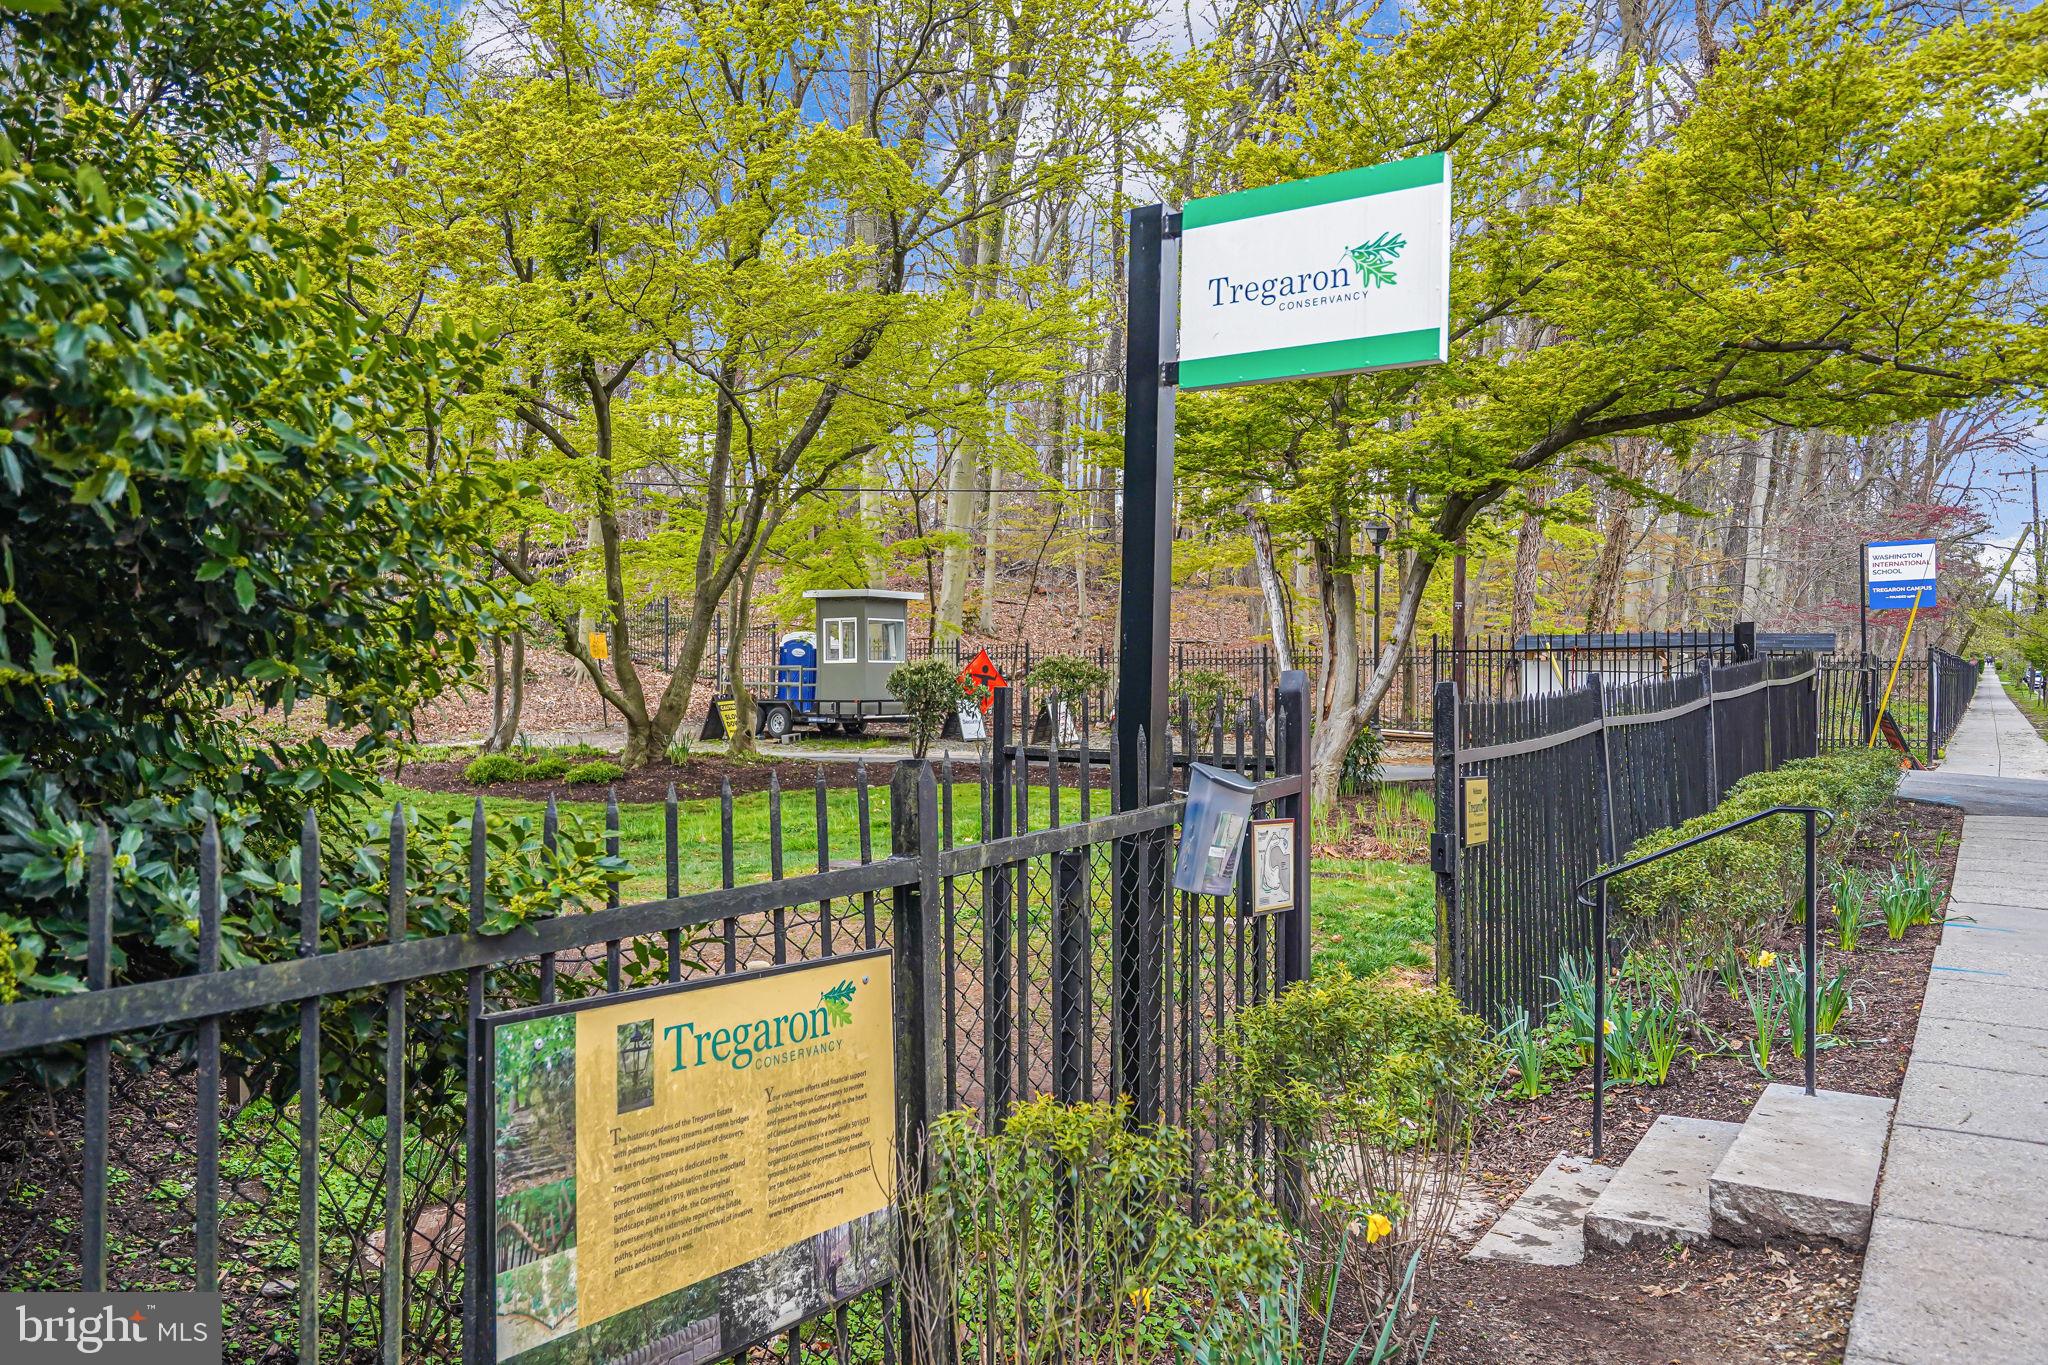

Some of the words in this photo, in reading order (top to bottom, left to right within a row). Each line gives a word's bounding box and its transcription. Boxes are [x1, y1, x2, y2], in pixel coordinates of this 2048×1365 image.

[1208, 267, 1351, 308] Tregaron
[1278, 290, 1369, 311] CONSERVANCY
[1872, 552, 1923, 560] WASHINGTON
[1872, 560, 1931, 568] INTERNATIONAL
[664, 1006, 830, 1072] Tregaron
[755, 1039, 843, 1070] CONSERVANCY
[766, 1105, 783, 1115] enable
[793, 1097, 814, 1107] Tregaron
[814, 1089, 843, 1102] Conservancy
[849, 1083, 864, 1091] restore
[781, 1087, 805, 1099] volunteer
[805, 1083, 820, 1091] efforts
[830, 1074, 849, 1085] financial
[849, 1070, 867, 1080] support
[628, 1131, 649, 1142] historic
[650, 1124, 673, 1136] gardens
[675, 1120, 681, 1128] of
[682, 1118, 691, 1126] the
[692, 1113, 716, 1124] Tregaron
[717, 1107, 732, 1117] Estate
[766, 1119, 777, 1127] and
[777, 1113, 798, 1125] preserve
[799, 1110, 807, 1118] this
[808, 1102, 831, 1114] woodland
[831, 1100, 841, 1109] gem
[855, 1092, 867, 1100] heart
[613, 1149, 626, 1159] with
[658, 1135, 680, 1146] flowing
[681, 1129, 702, 1139] streams
[703, 1124, 714, 1133] and
[715, 1121, 729, 1130] stone
[730, 1115, 749, 1126] bridges
[767, 1132, 773, 1140] of
[773, 1126, 797, 1138] Cleveland
[798, 1122, 806, 1130] and
[807, 1116, 827, 1128] Woodley
[768, 1144, 789, 1155] Tregaron
[790, 1135, 819, 1148] Conservancy
[633, 1155, 660, 1168] enduring
[661, 1148, 684, 1159] treasure
[685, 1143, 695, 1152] and
[696, 1138, 711, 1150] place
[712, 1135, 718, 1143] of
[767, 1153, 798, 1167] organization
[799, 1143, 823, 1157] committed
[829, 1135, 850, 1147] restoring
[767, 1168, 788, 1180] grounds
[796, 1159, 811, 1170] public
[838, 1147, 848, 1155] Your
[848, 1140, 870, 1152] donations
[614, 1180, 640, 1193] Tregaron
[642, 1168, 678, 1184] Conservancy
[685, 1158, 711, 1171] dedicated
[712, 1155, 718, 1163] to
[720, 1152, 728, 1160] the
[614, 1191, 652, 1209] preservation
[652, 1186, 663, 1195] and
[665, 1174, 702, 1191] rehabilitation
[703, 1170, 709, 1178] of
[710, 1167, 718, 1176] the
[720, 1158, 745, 1173] woodland
[768, 1199, 777, 1209] For
[813, 1181, 825, 1190] ways
[825, 1179, 834, 1188] you
[855, 1165, 871, 1176] contact
[614, 1208, 635, 1223] garden
[636, 1198, 664, 1214] designed
[686, 1186, 699, 1197] With
[700, 1184, 709, 1192] the
[710, 1177, 730, 1190] original
[614, 1219, 645, 1235] landscape
[646, 1215, 658, 1228] plan
[690, 1200, 699, 1209] the
[700, 1189, 734, 1205] Conservancy
[769, 1187, 844, 1219] www.tregaronconservancy.org
[621, 1230, 653, 1246] overseeing
[654, 1226, 664, 1235] the
[665, 1216, 691, 1231] extensive
[693, 1211, 709, 1222] repair
[716, 1205, 725, 1213] the
[726, 1198, 741, 1209] bridle
[634, 1239, 665, 1257] pedestrian
[667, 1234, 680, 1243] trails
[682, 1228, 692, 1238] and
[694, 1225, 703, 1233] the
[704, 1218, 725, 1231] removal
[726, 1215, 732, 1223] of
[732, 1207, 754, 1220] invasive
[615, 1265, 634, 1278] plants
[635, 1260, 646, 1269] and
[647, 1247, 677, 1265] hazardous
